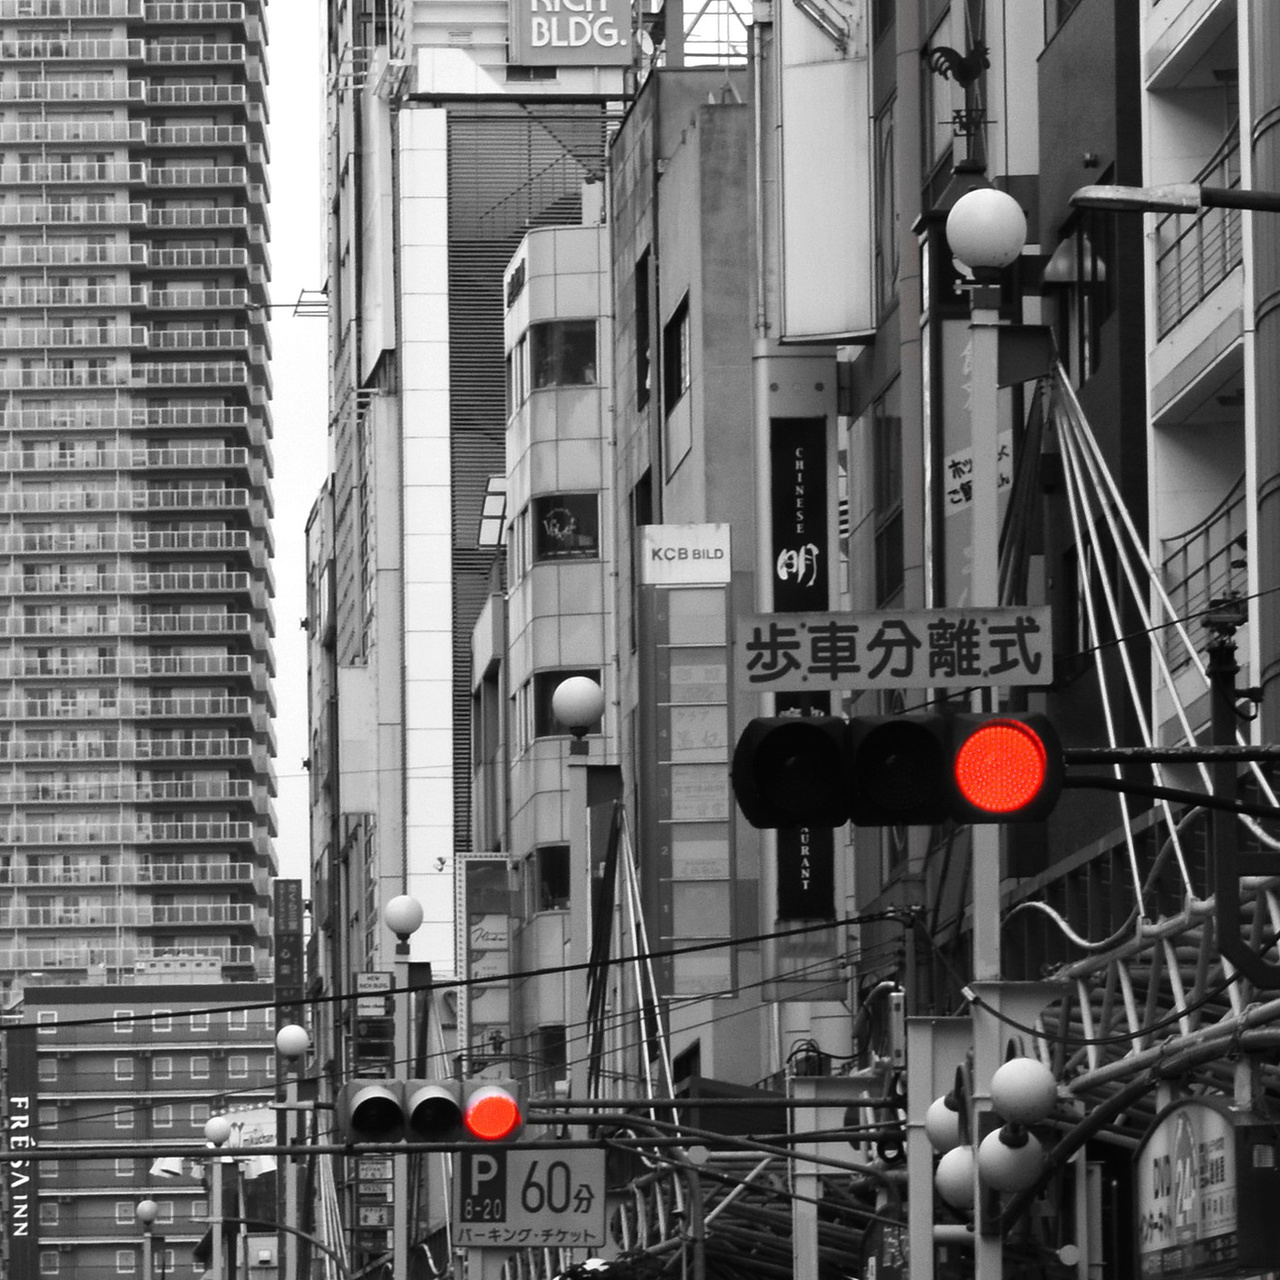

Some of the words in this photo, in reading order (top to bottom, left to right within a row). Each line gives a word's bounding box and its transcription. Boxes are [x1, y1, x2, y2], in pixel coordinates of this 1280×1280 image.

[794, 447, 805, 534] CHINESE
[651, 547, 689, 561] KCB
[692, 548, 724, 560] BILD
[746, 616, 1042, 683] 歩車分離式
[471, 1154, 499, 1196] P
[521, 1160, 595, 1214] 60分
[12, 1195, 28, 1237] INN
[465, 1198, 502, 1219] 8-20
[457, 1228, 596, 1243] パーキング・チケット
